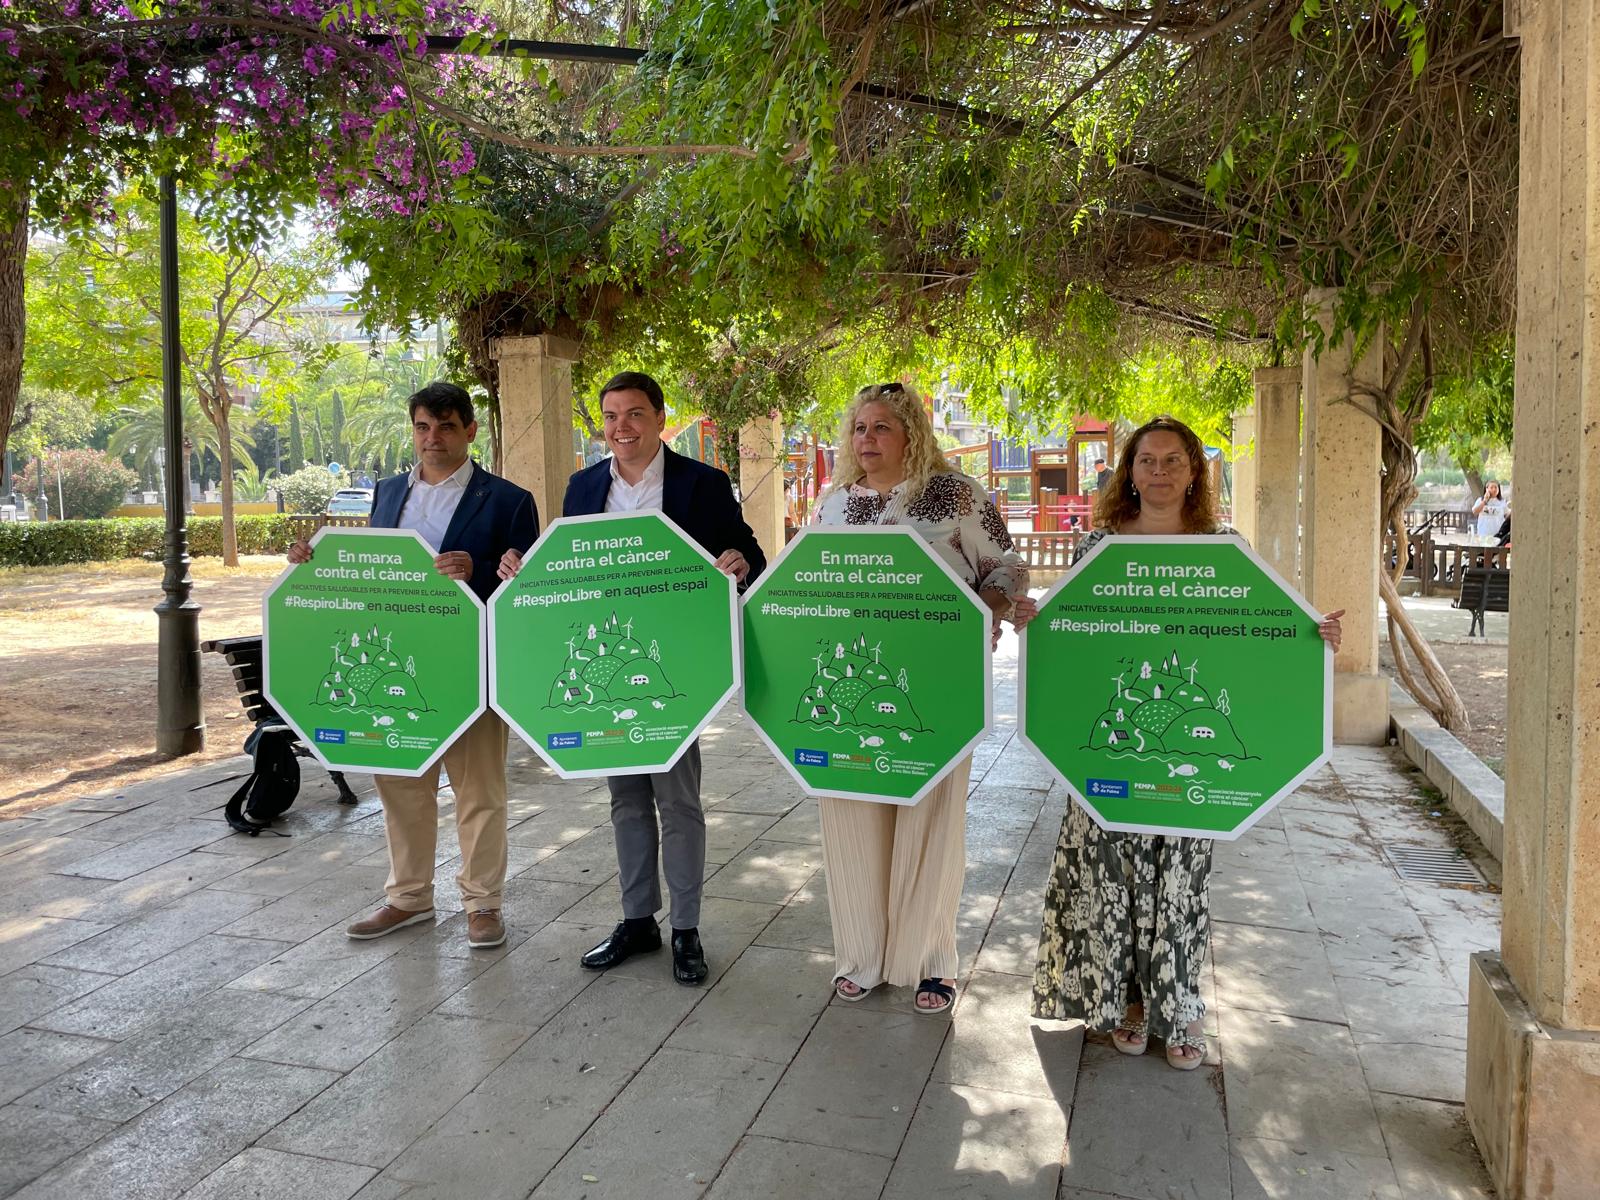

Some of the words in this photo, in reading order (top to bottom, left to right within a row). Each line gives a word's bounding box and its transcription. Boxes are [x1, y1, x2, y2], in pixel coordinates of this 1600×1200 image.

[572, 539, 590, 552] En
[595, 536, 642, 550] marxa
[338, 550, 355, 562] En
[359, 552, 402, 564] marxa
[546, 556, 595, 571] contra
[599, 552, 614, 566] el
[617, 549, 671, 564] càncer
[822, 551, 839, 564] En
[845, 553, 893, 565] marxa
[315, 567, 359, 579] contra
[362, 568, 375, 580] el
[379, 568, 428, 582] càncer
[795, 570, 844, 583] contra
[848, 570, 863, 583] el
[867, 570, 923, 584] càncer
[1126, 563, 1149, 577] En
[1154, 565, 1215, 578] marxa
[520, 579, 559, 589] INICIATIVES
[560, 575, 605, 585] SALUDABLES
[628, 569, 663, 578] PREVENIR
[513, 590, 602, 607] #RespiroLibre
[605, 588, 620, 597] en
[624, 583, 669, 598] aquest
[673, 577, 708, 593] espai
[1093, 582, 1154, 596] contra
[1159, 582, 1178, 597] el
[1182, 583, 1251, 598] càncer
[285, 596, 365, 611] #RespiroLibre
[368, 603, 382, 611] en
[384, 602, 425, 615] aquest
[429, 604, 460, 616] espai
[762, 603, 850, 618] #RespiroLibre
[854, 607, 869, 617] en
[874, 608, 920, 621] aquest
[925, 609, 960, 624] espai
[1109, 605, 1166, 614] SALUDABLES
[1254, 607, 1292, 617] CÀNCER
[1050, 619, 1160, 635] #RespiroLibre
[1164, 623, 1185, 634] en
[1189, 624, 1247, 638] aquest
[1251, 624, 1296, 640] espai
